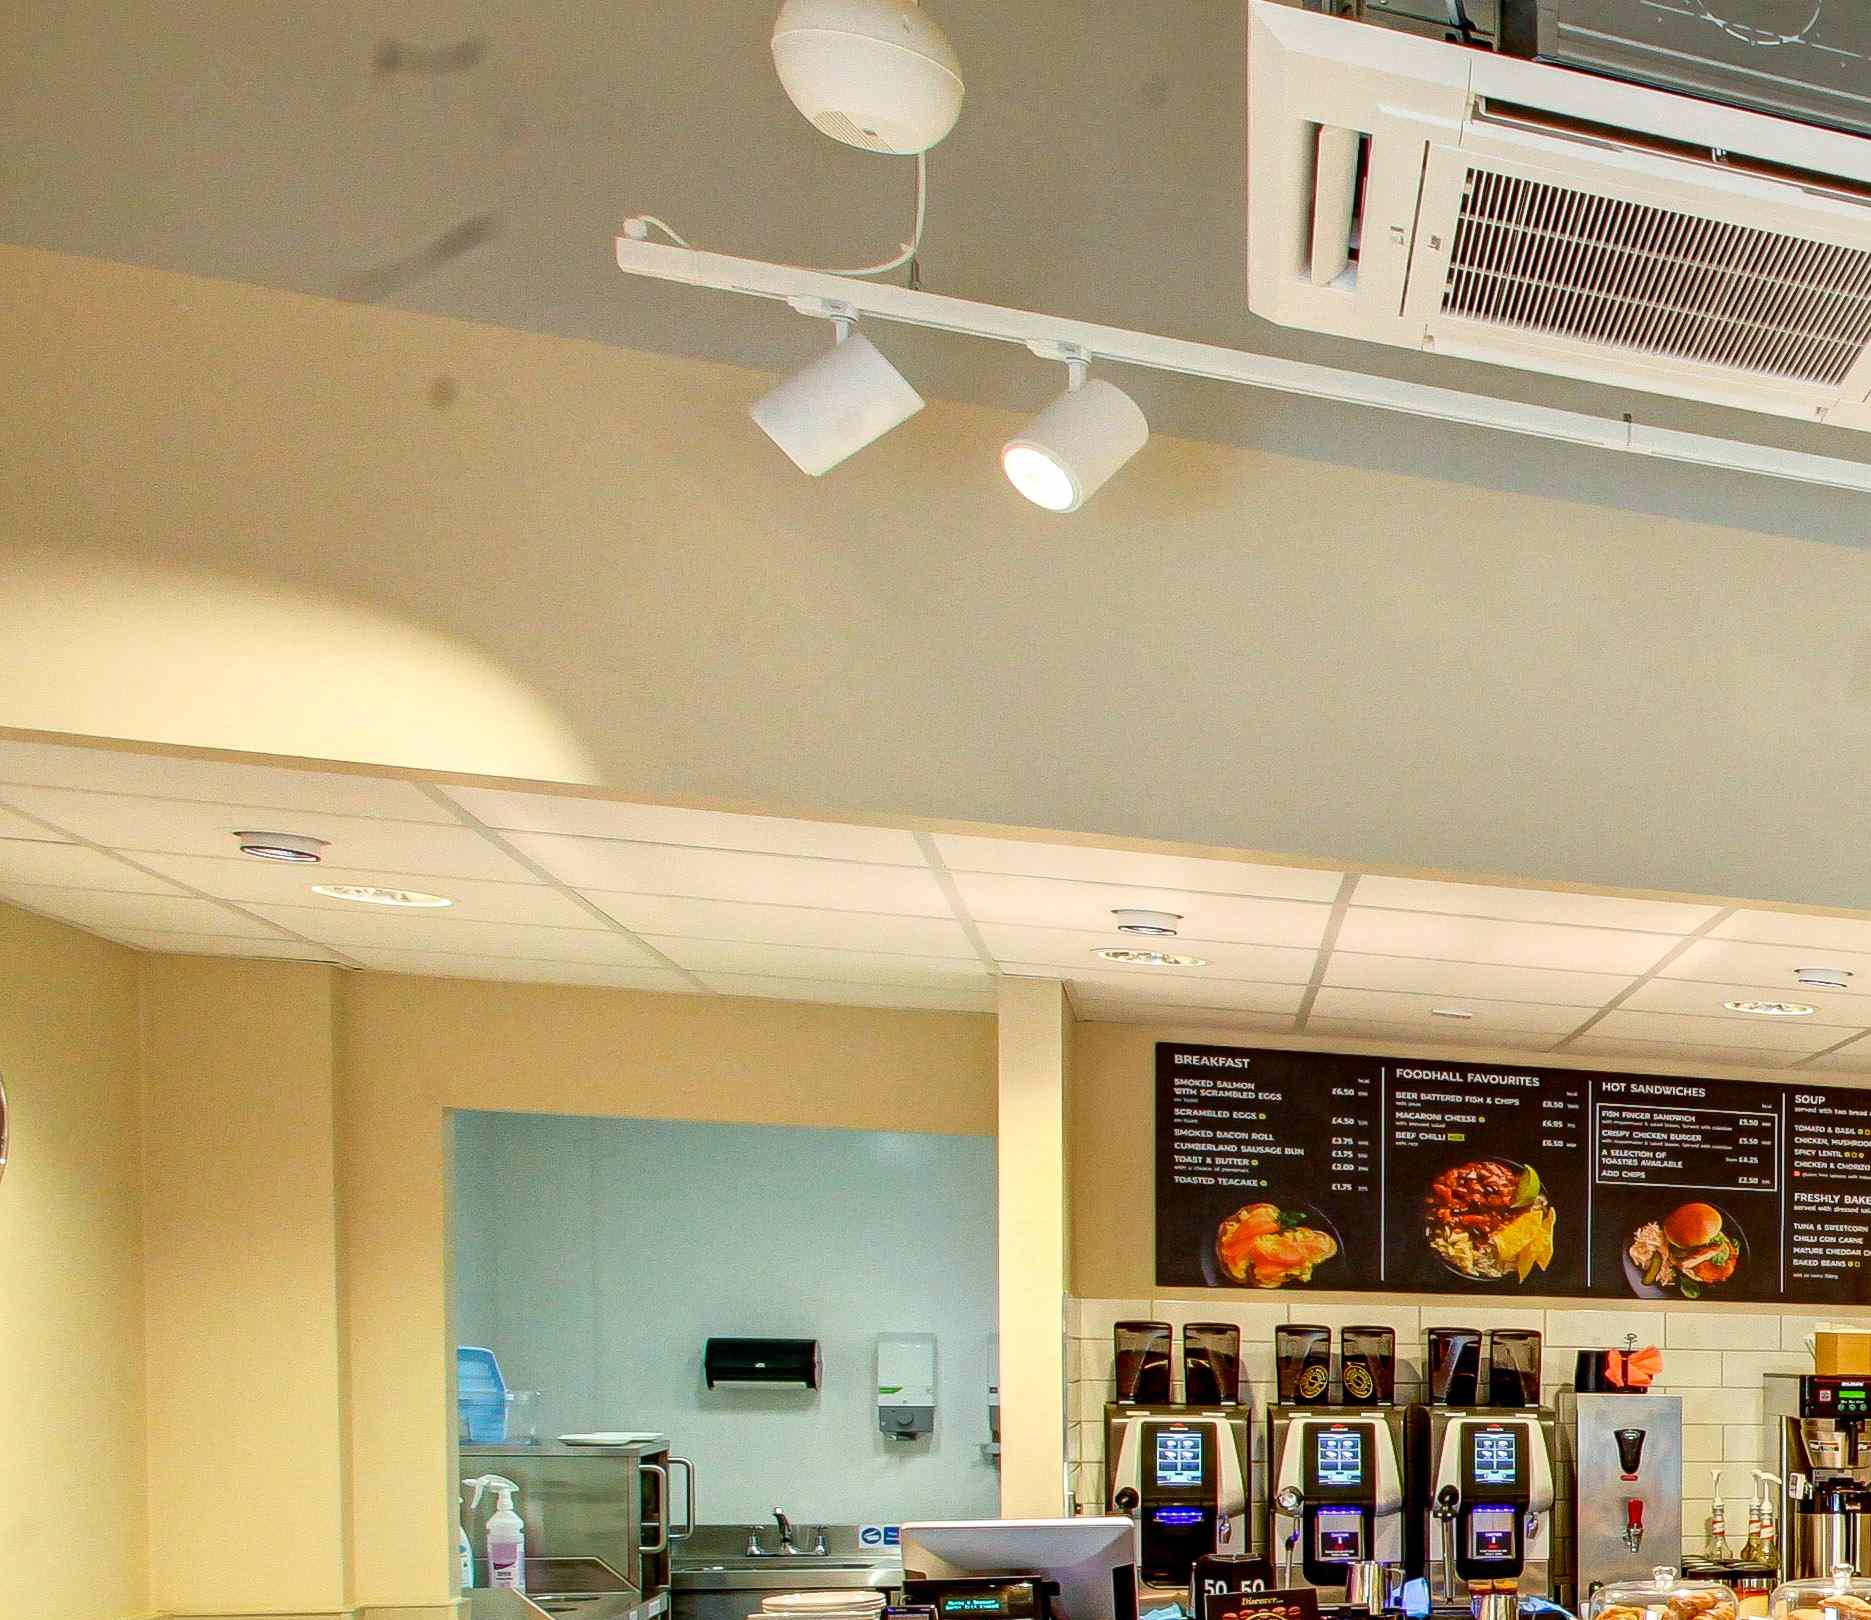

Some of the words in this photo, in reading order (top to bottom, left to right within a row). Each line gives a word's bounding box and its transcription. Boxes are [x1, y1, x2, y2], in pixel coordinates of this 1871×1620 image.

[1174, 1054, 1250, 1069] BREAKFAST
[1396, 1068, 1463, 1082] FOODHALL
[1467, 1073, 1541, 1087] FAVOURITES
[1174, 1078, 1213, 1088] SMOKED
[1216, 1081, 1255, 1090] SALMON
[1602, 1082, 1627, 1092] HOT
[1630, 1083, 1706, 1098] SANDWICHES
[1200, 1089, 1256, 1099] SCRAMBLED
[1258, 1092, 1282, 1101] EGGS
[1795, 1095, 1825, 1105] SOUP
[1173, 1108, 1230, 1119] SCRAMBLED
[1233, 1111, 1257, 1120] EGGS
[1395, 1112, 1442, 1121] MACARONI
[1174, 1128, 1213, 1138] SMOKED
[1251, 1133, 1274, 1141] ROLL
[1794, 1192, 1840, 1204] FRESHLY
[1203, 1578, 1228, 1595] 50
[1240, 1578, 1265, 1593] 50
